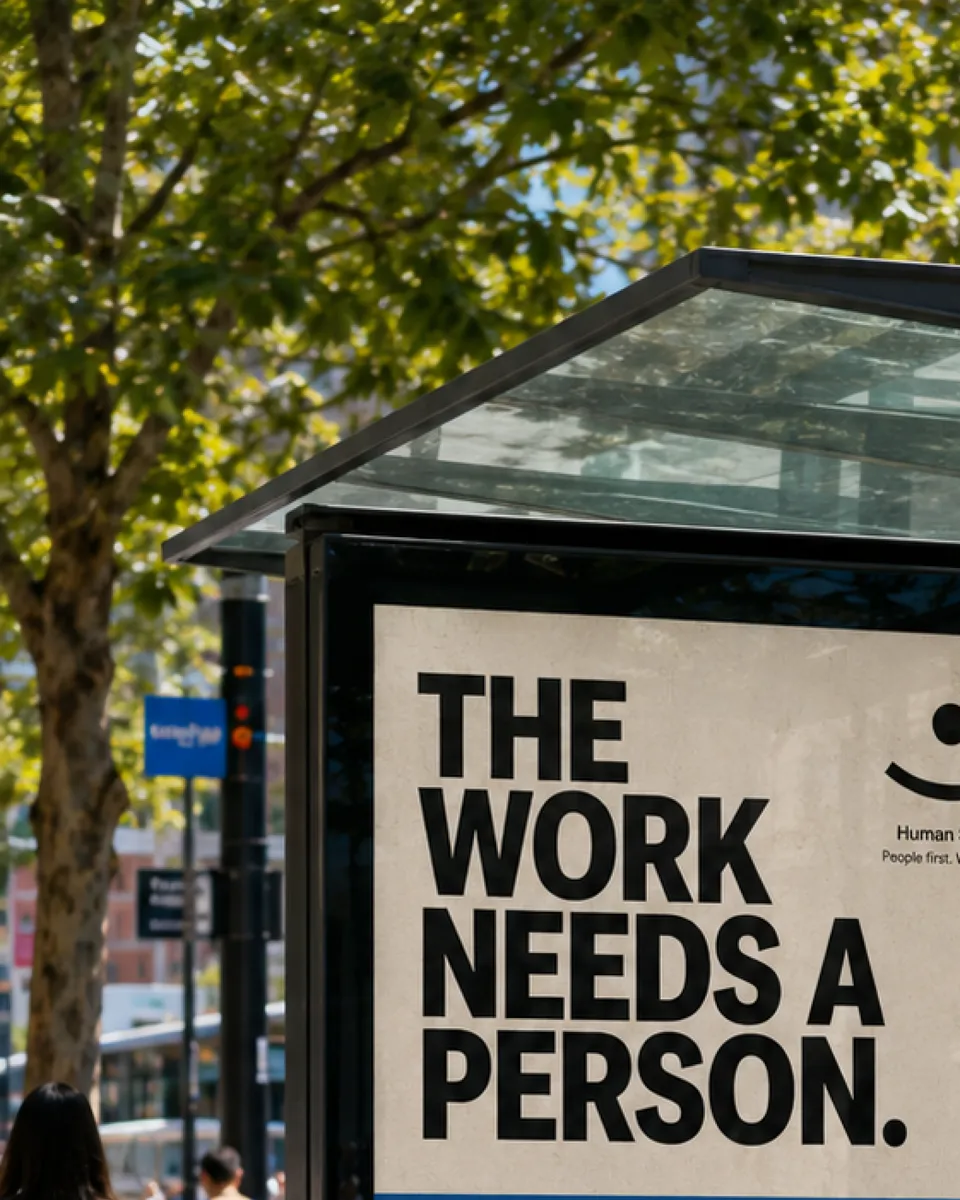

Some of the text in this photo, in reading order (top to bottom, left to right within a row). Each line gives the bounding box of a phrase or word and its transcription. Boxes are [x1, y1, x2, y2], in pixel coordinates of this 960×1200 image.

[417, 672, 629, 784] THE
[418, 787, 773, 905] WORK
[882, 849, 923, 867] People
[925, 851, 953, 865] first.
[897, 824, 954, 842] Human
[422, 907, 885, 1027] NEEDS A
[422, 1028, 908, 1147] PERSON.
